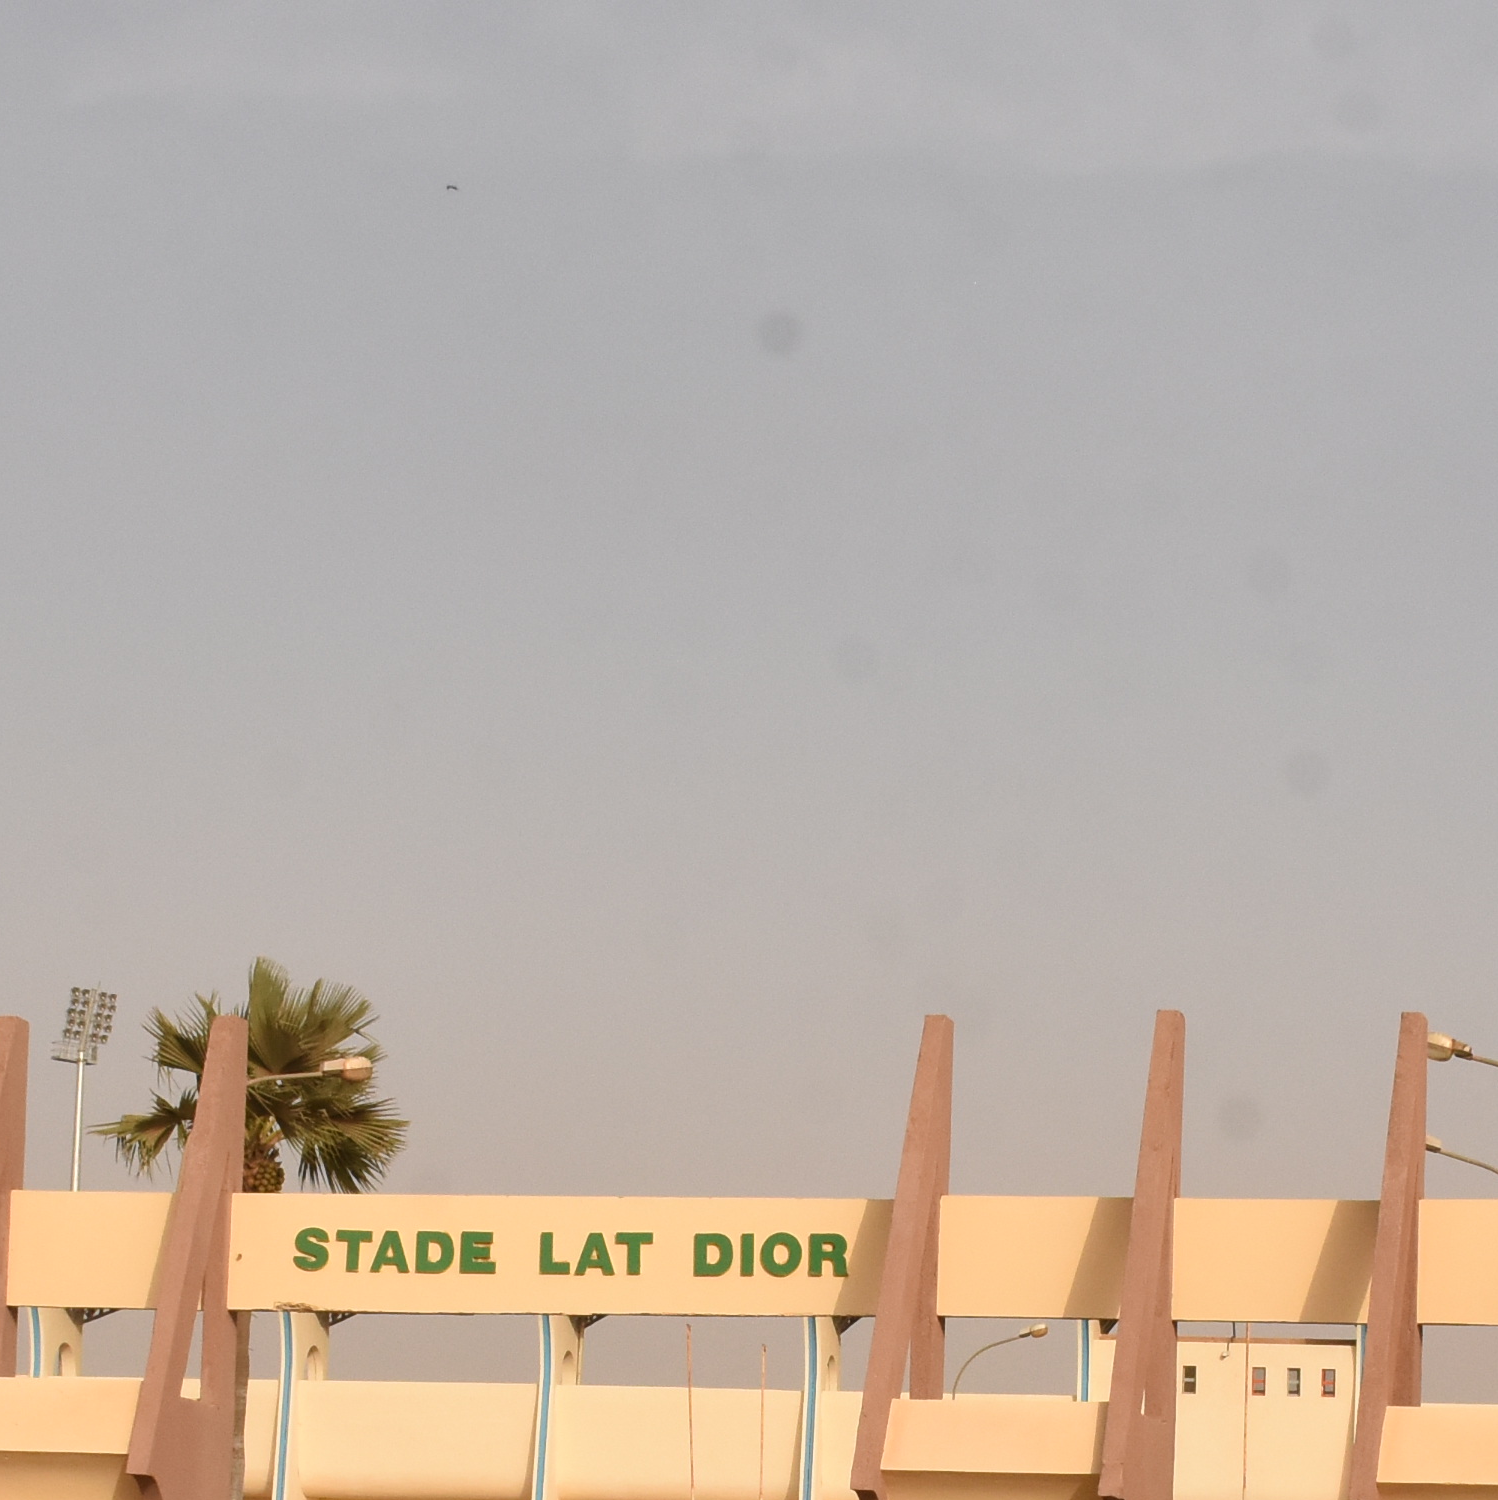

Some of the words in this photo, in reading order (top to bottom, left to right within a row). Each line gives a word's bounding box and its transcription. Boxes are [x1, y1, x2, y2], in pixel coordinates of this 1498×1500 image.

[292, 1227, 497, 1275] STADE
[538, 1231, 654, 1276] LAT
[691, 1232, 849, 1279] DIOR
